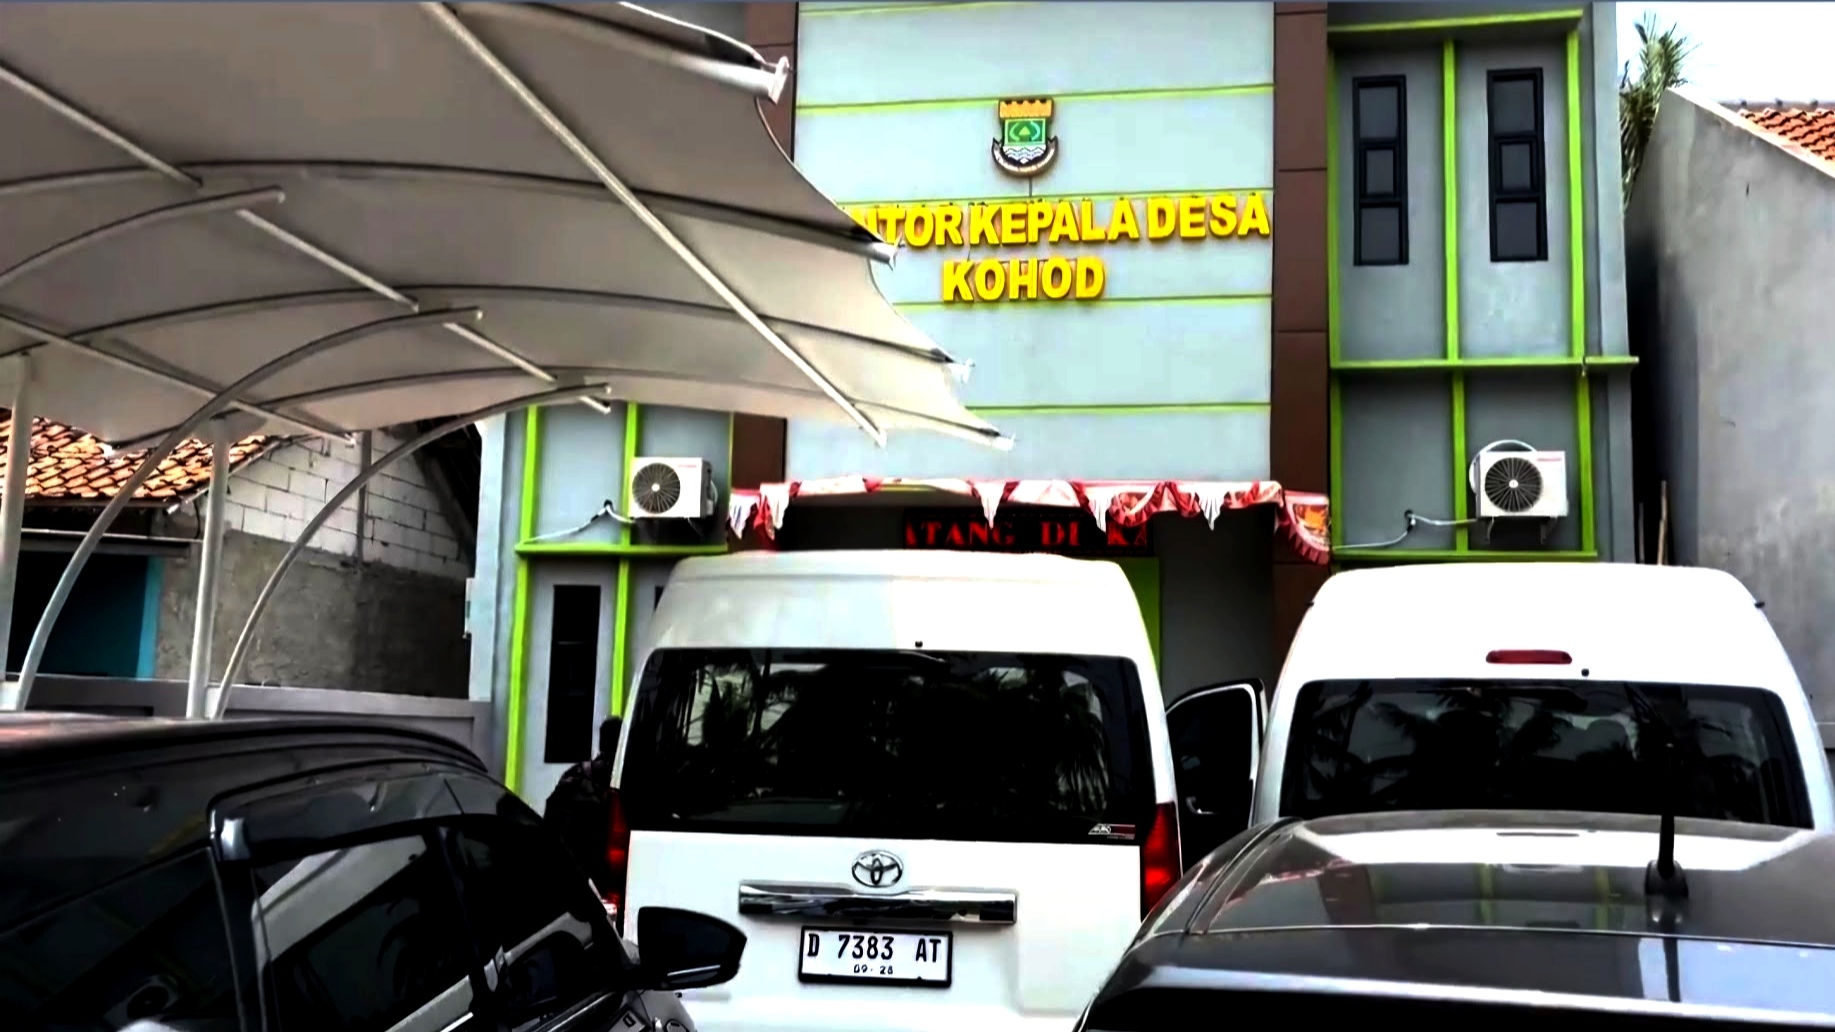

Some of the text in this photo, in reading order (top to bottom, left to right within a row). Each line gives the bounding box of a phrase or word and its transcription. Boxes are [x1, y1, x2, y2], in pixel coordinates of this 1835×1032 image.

[968, 197, 1140, 245] KEPALA
[1146, 192, 1270, 240] DESA
[943, 257, 1104, 302] KOHOD
[1039, 520, 1081, 546] DI
[807, 933, 942, 962] D 7383 AT
